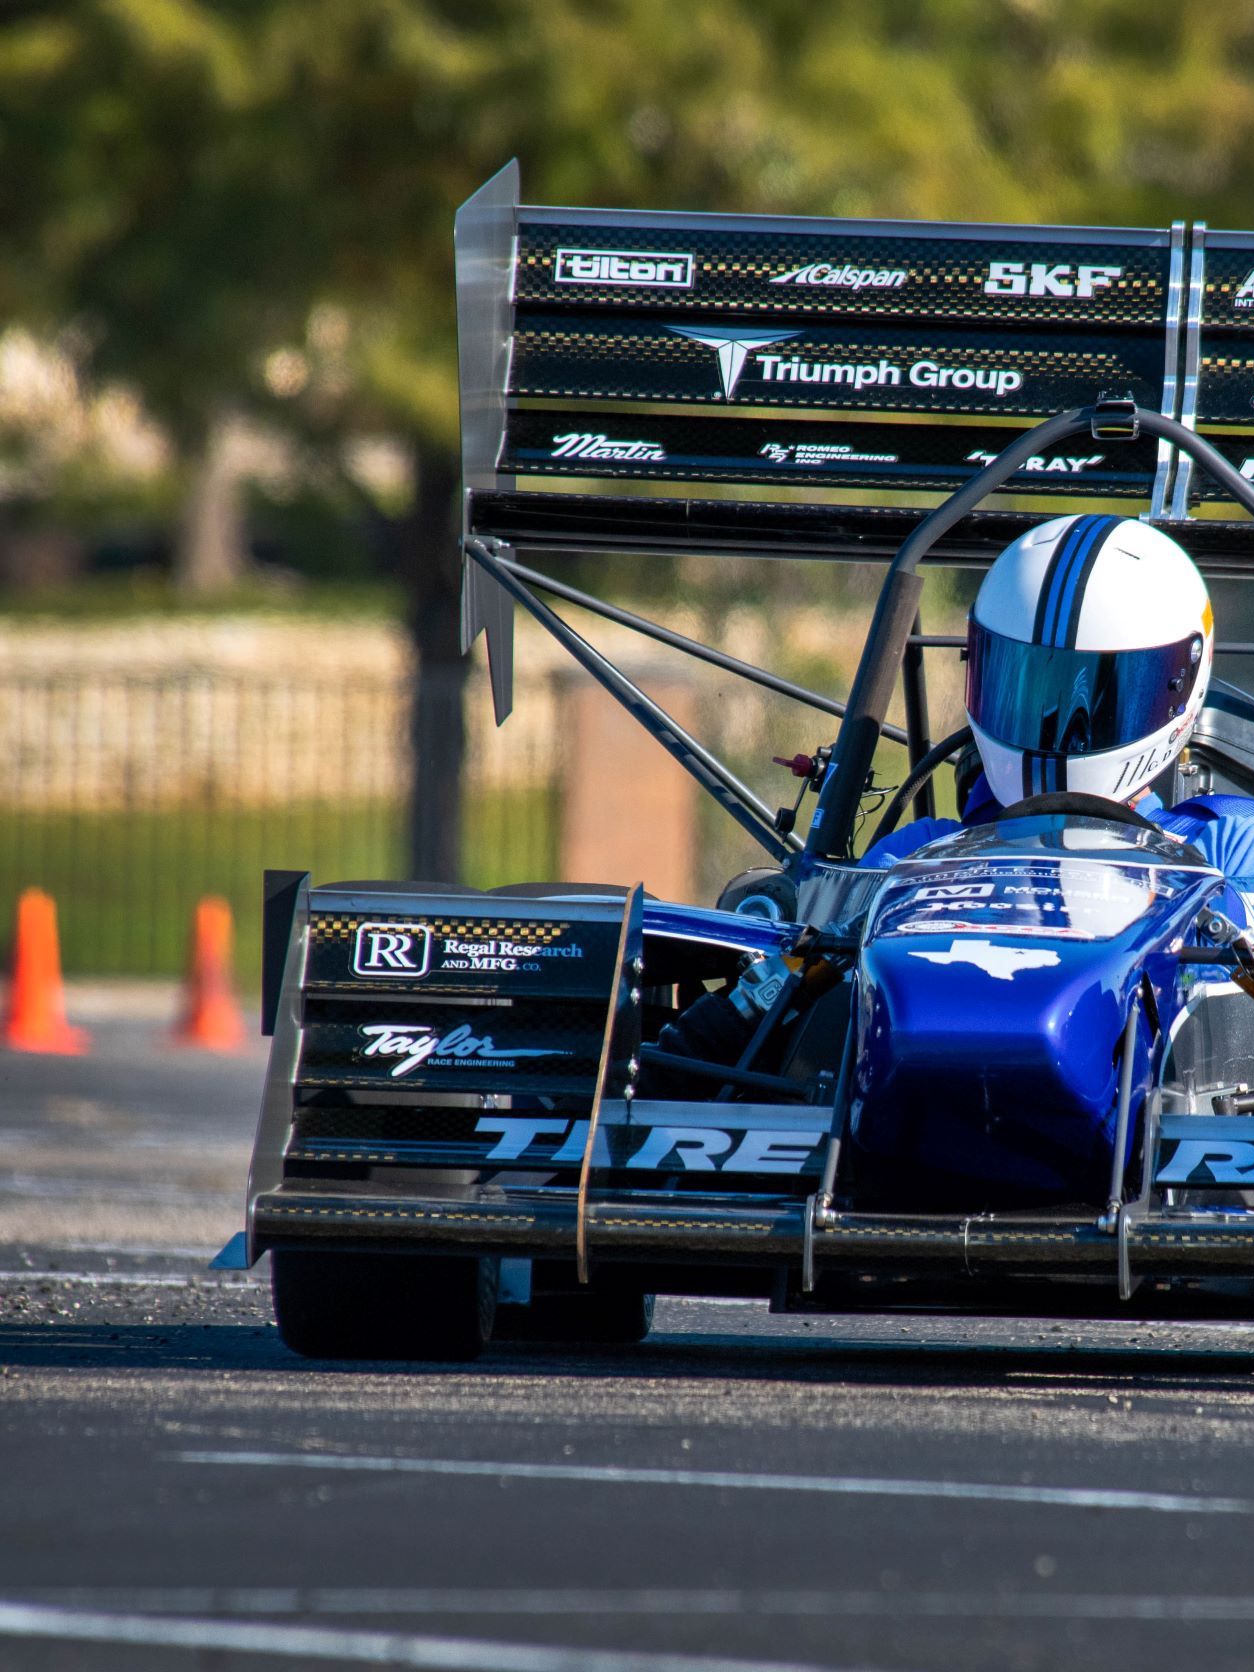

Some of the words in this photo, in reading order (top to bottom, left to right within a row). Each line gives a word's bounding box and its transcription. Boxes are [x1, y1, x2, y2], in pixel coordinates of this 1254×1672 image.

[807, 264, 906, 290] Calspan
[984, 262, 1121, 298] SKF
[756, 354, 900, 390] Triumph
[909, 360, 1022, 396] Group
[552, 433, 667, 462] Martin
[795, 452, 898, 462] ENGINEERING
[796, 444, 853, 453] ROMEO
[443, 939, 496, 958] Regal
[498, 940, 584, 958] Research
[441, 959, 469, 969] AND
[361, 1023, 560, 1077] Taylor
[427, 1058, 452, 1067] RACE
[454, 1058, 515, 1068] ENGINEERING
